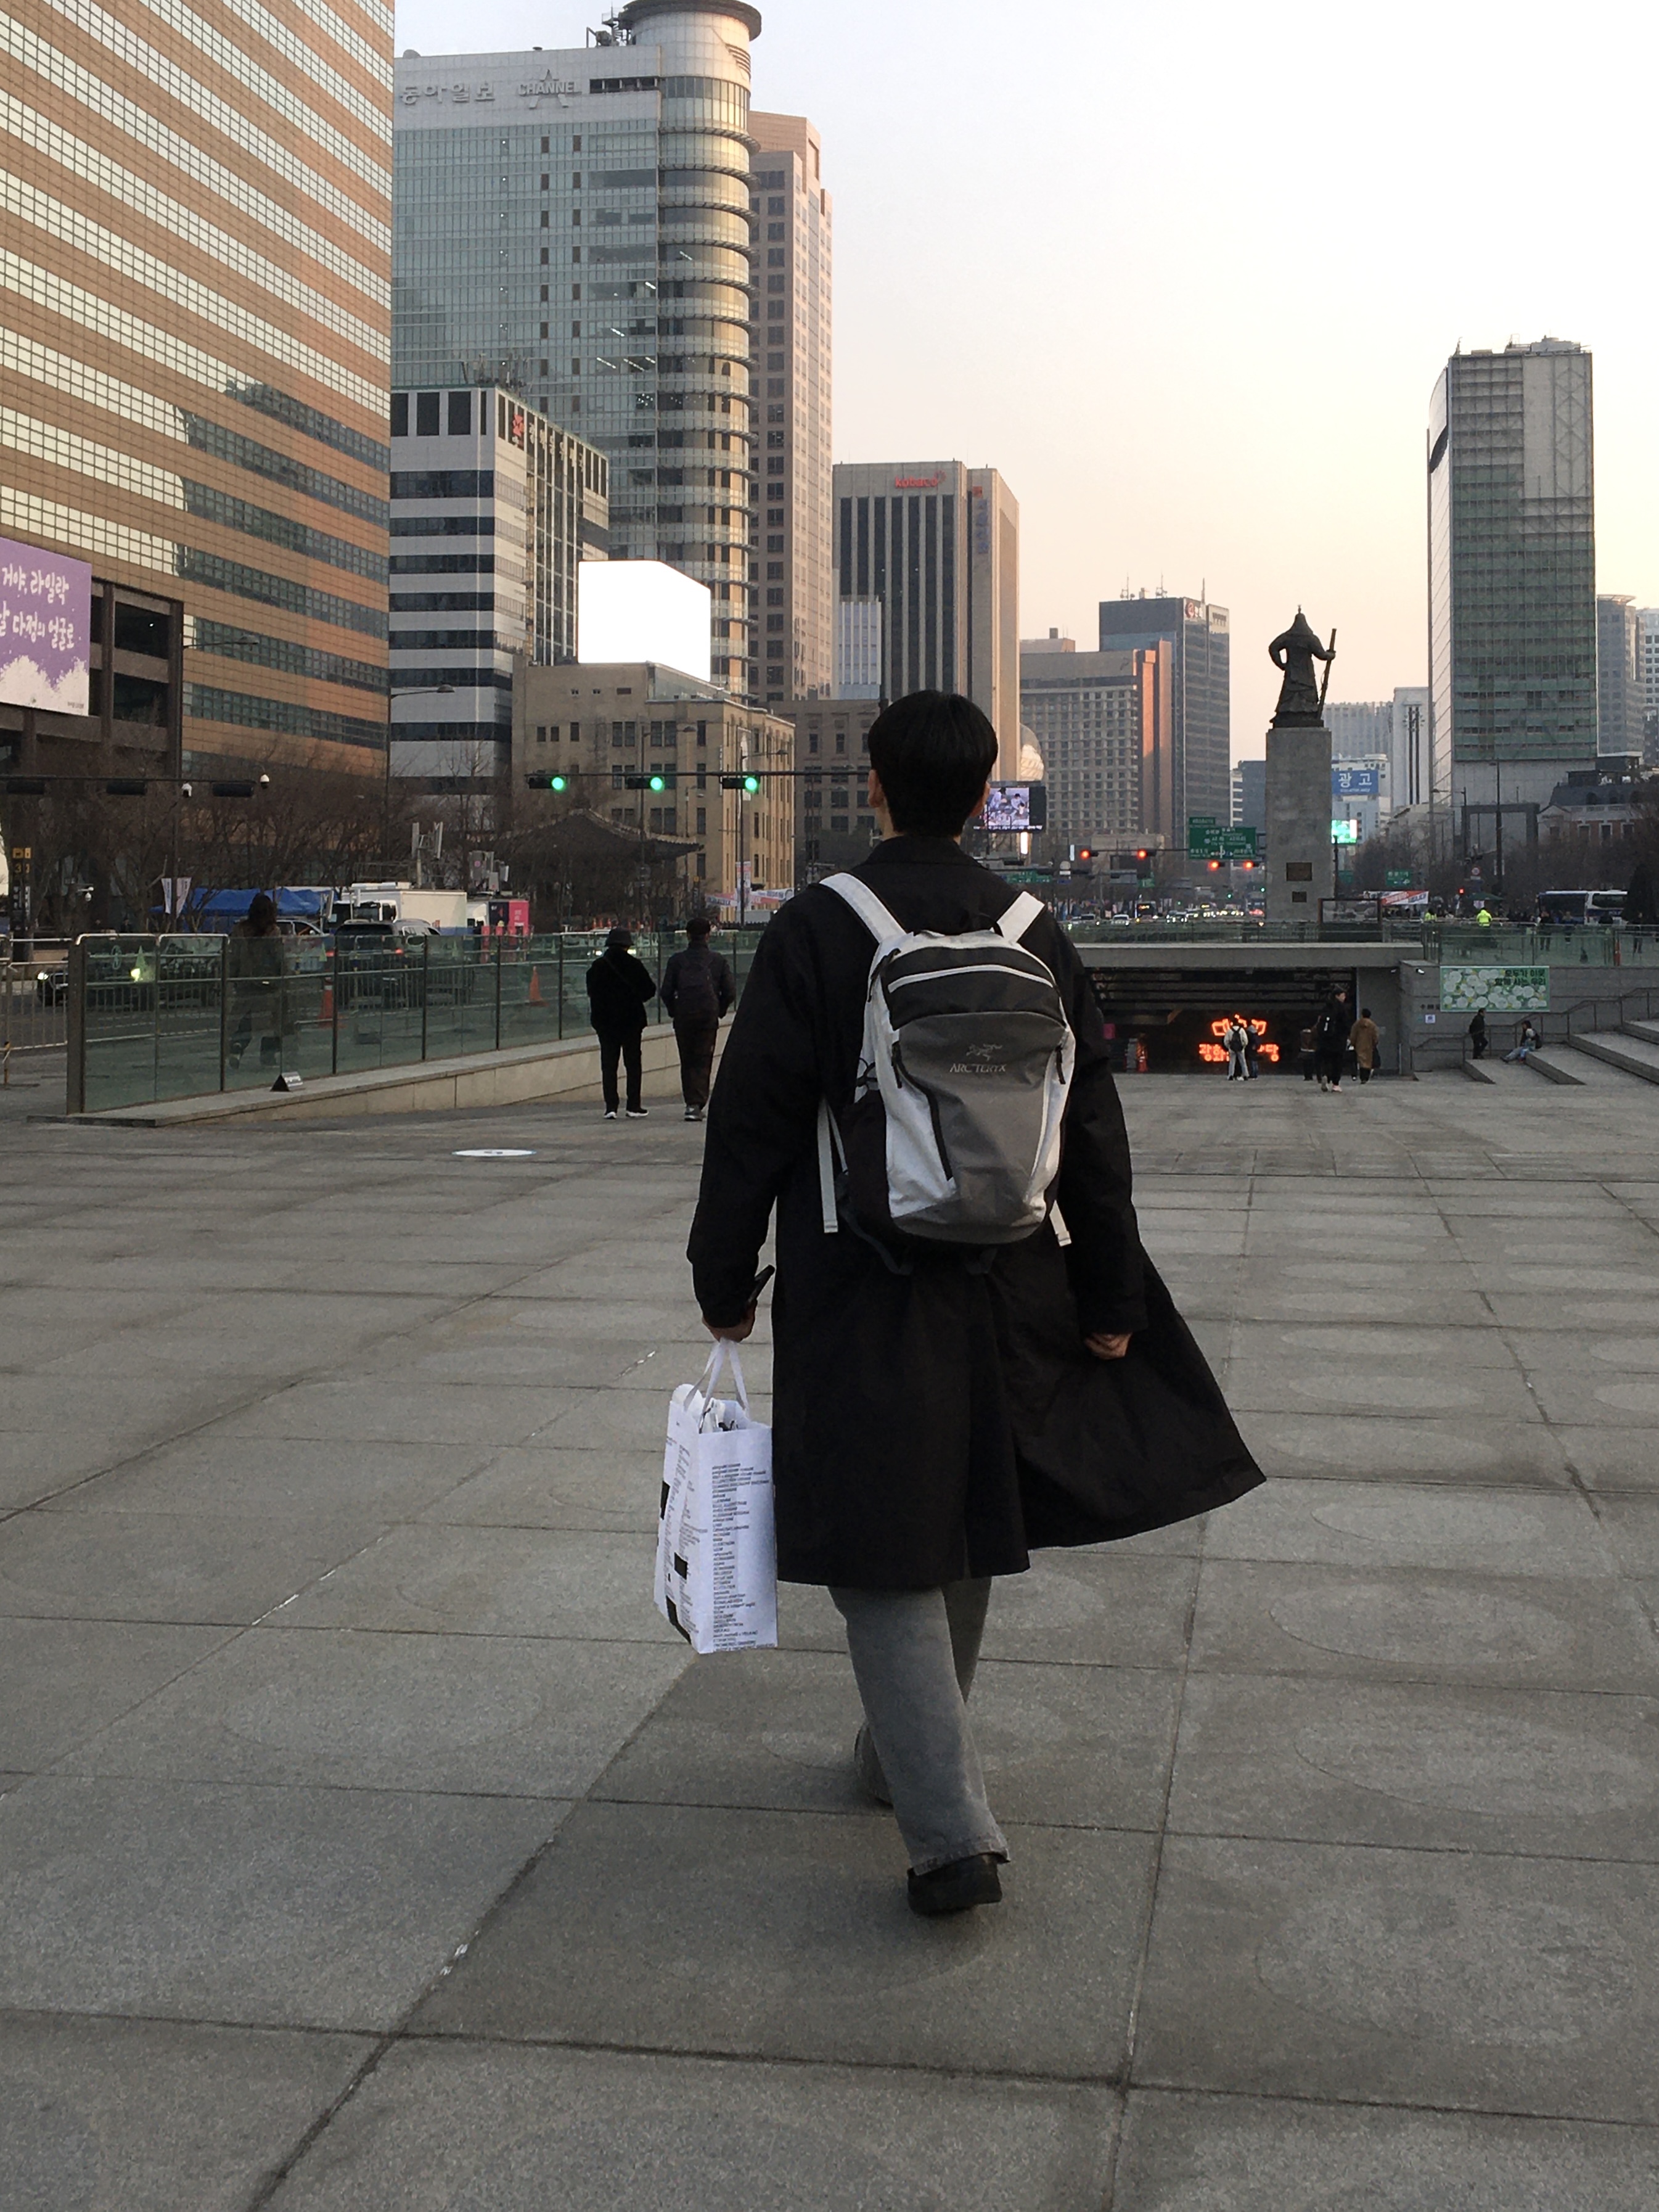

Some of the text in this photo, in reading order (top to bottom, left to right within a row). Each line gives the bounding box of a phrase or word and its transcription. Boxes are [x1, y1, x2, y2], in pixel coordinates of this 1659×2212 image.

[401, 83, 495, 105] 동아일보
[518, 81, 583, 96] CHANNEL
[895, 476, 938, 488] kobaco
[30, 569, 69, 605] 라일락
[12, 611, 45, 644] 다정의
[48, 617, 75, 651] 얼굴로
[1338, 773, 1372, 788] 광고
